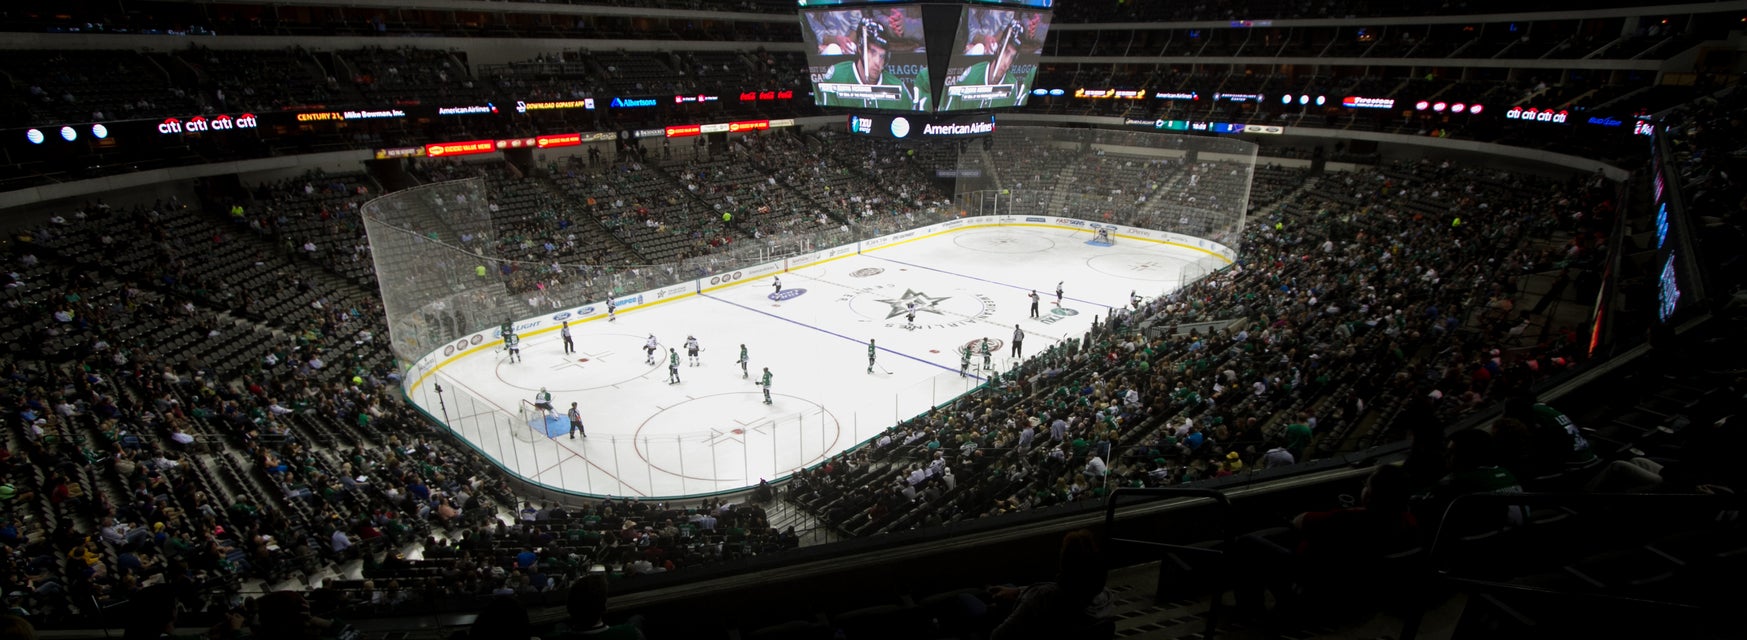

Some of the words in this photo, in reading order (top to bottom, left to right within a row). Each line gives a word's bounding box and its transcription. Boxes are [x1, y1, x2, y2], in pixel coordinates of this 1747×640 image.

[526, 102, 555, 110] DOWNLOAD
[623, 98, 657, 107] Albertsons
[1354, 97, 1394, 105] Firestone
[297, 112, 331, 121] CENTURY
[343, 110, 361, 120] Mike
[392, 109, 405, 117] Inc.
[439, 106, 468, 115] American
[468, 105, 490, 114] Airlines
[158, 120, 182, 133] citi
[185, 118, 208, 132] citi
[211, 117, 233, 130] citi
[236, 115, 257, 128] citi
[859, 118, 872, 128] TXU
[923, 123, 970, 135] American
[970, 121, 992, 134] Airlines
[516, 320, 542, 331] LIGHT
